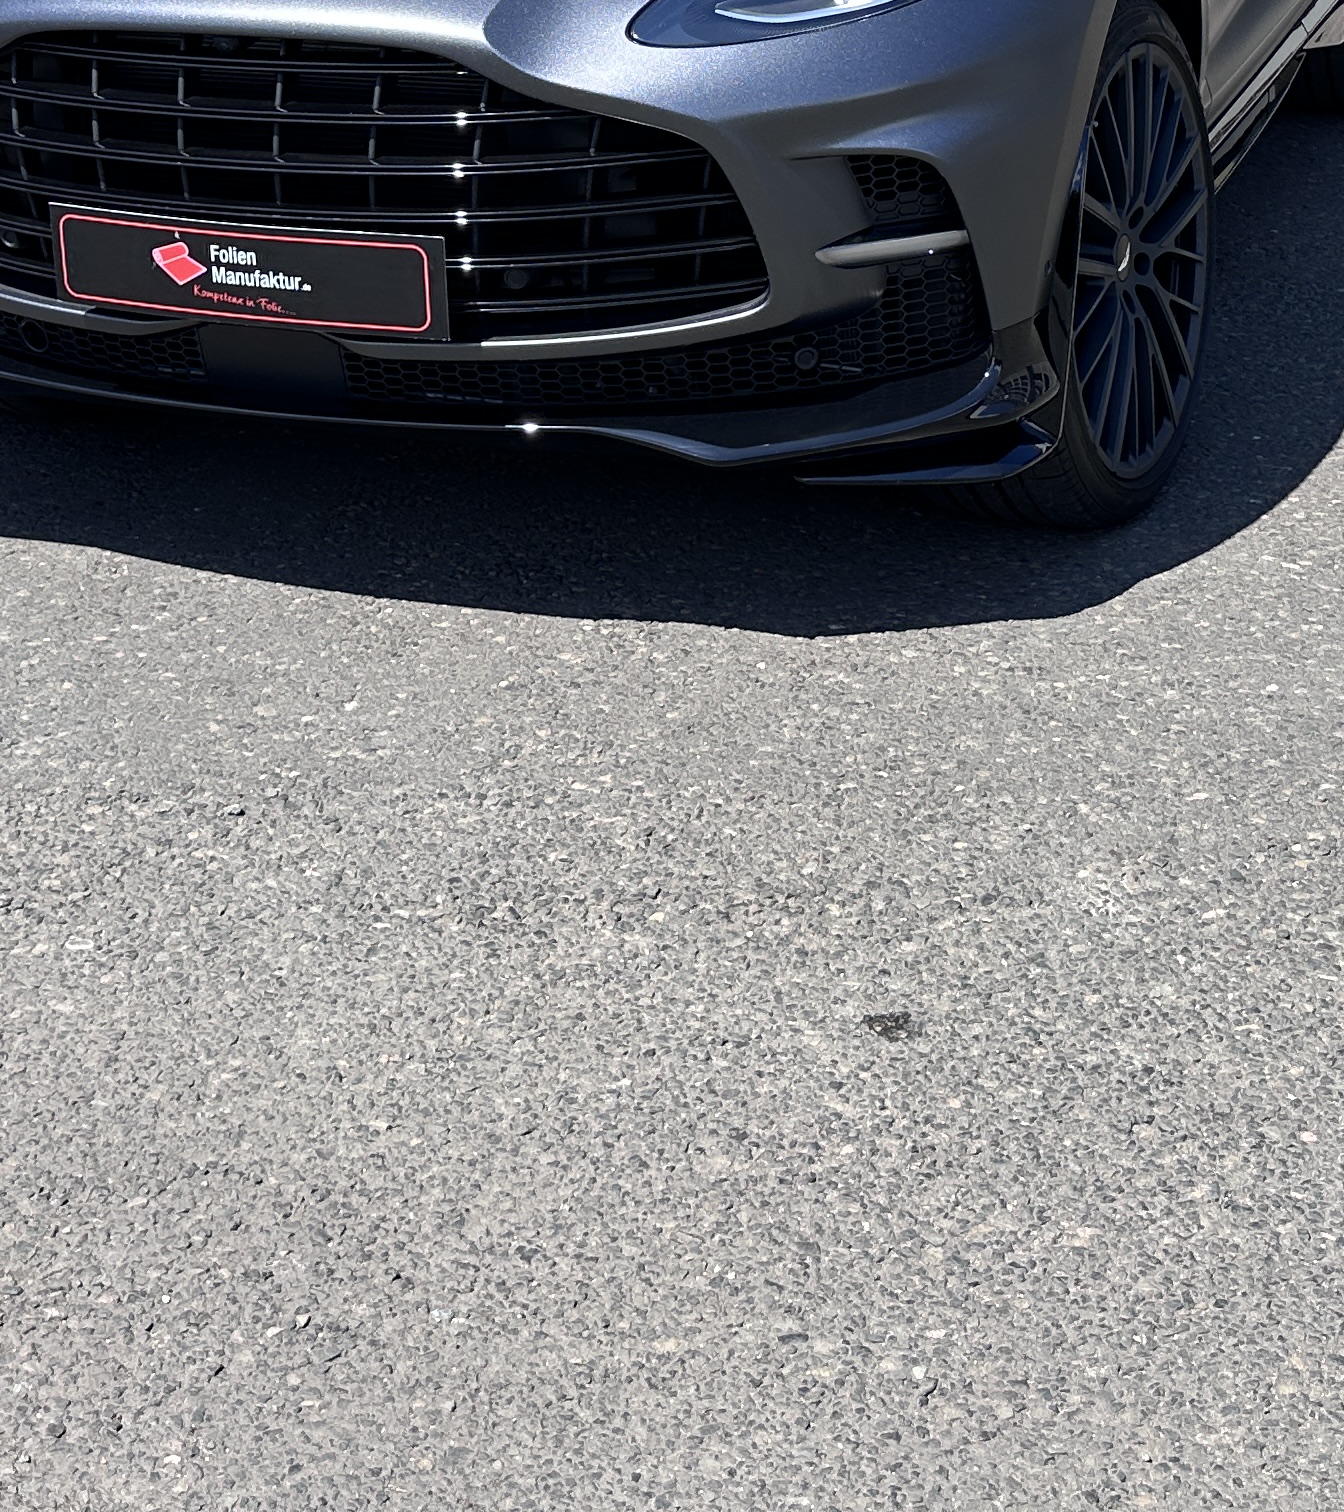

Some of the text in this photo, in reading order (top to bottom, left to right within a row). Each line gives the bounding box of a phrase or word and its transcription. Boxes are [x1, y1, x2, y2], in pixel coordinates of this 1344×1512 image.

[209, 244, 257, 266] Folien
[193, 284, 244, 303] Kompetenz
[246, 296, 255, 307] in
